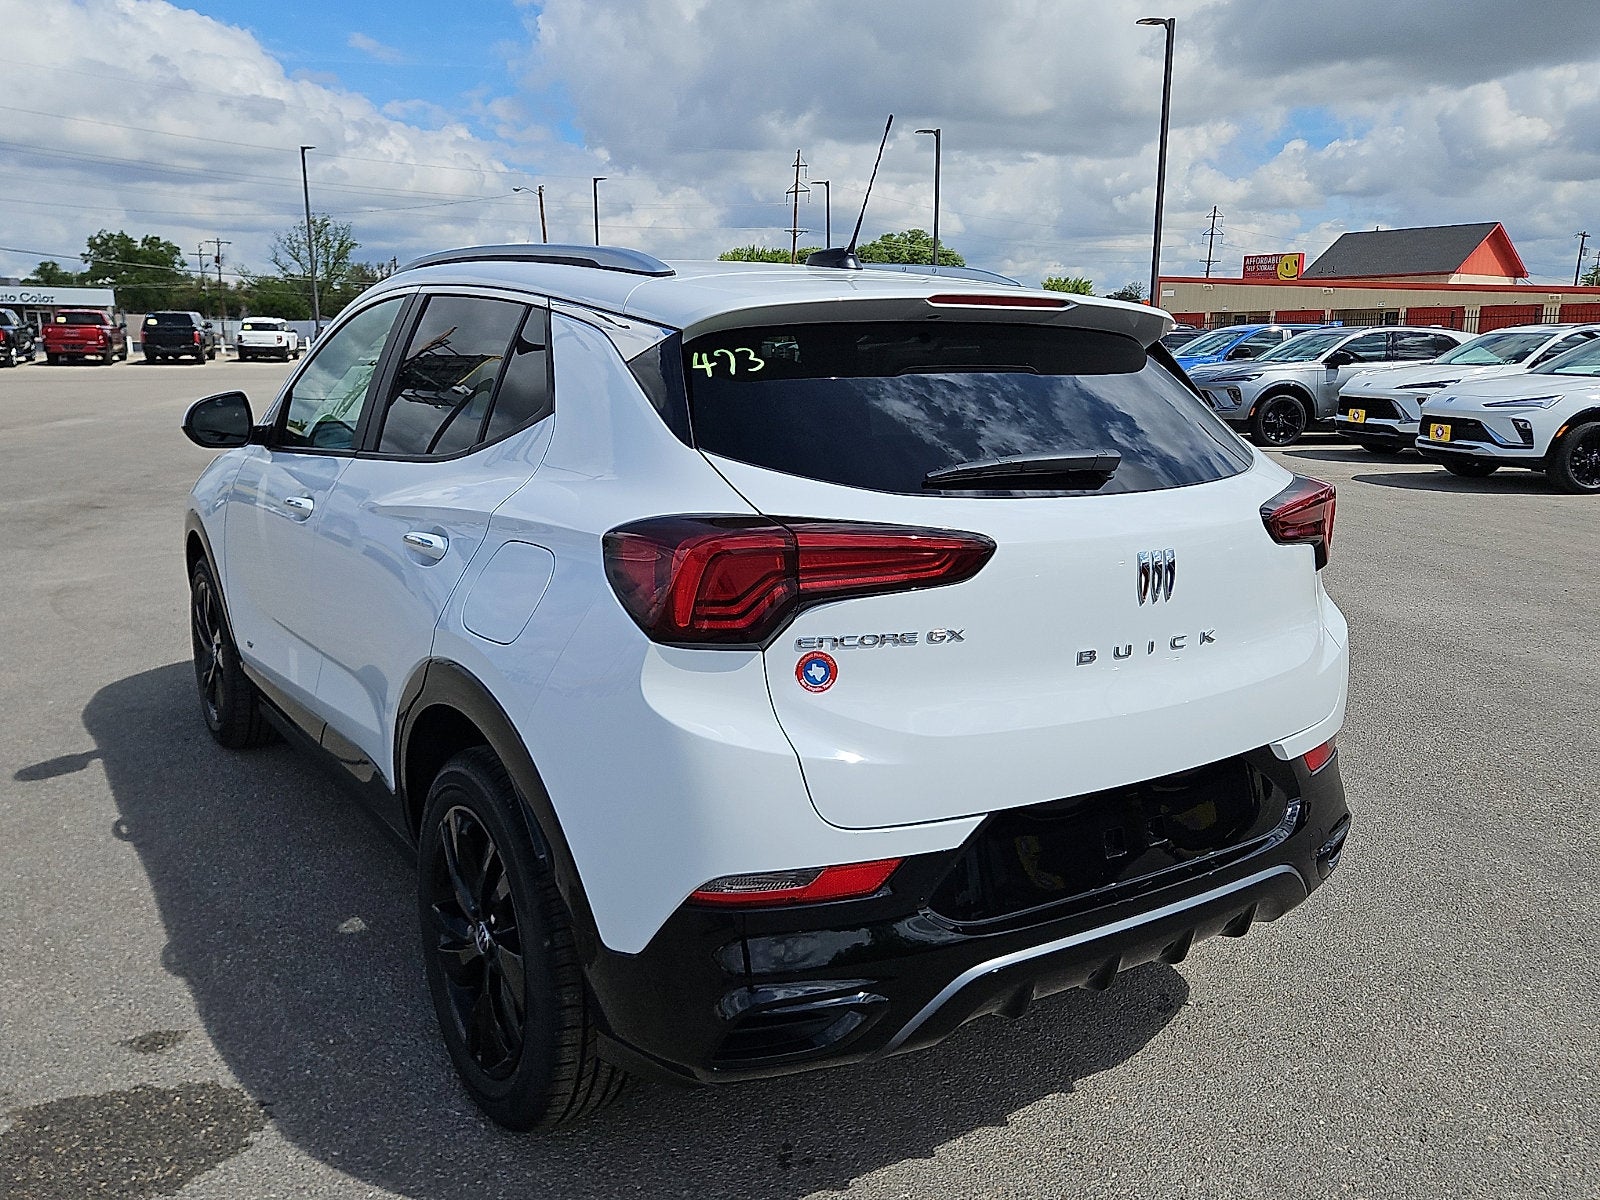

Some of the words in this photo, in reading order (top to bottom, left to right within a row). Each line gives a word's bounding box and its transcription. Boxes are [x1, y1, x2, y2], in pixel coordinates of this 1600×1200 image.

[1245, 256, 1282, 265] AFFORDABLE
[20, 292, 54, 303] Color
[692, 347, 765, 377] 473
[795, 632, 919, 651] ENCORE
[926, 628, 966, 645] GX
[1076, 629, 1216, 667] BUICK
